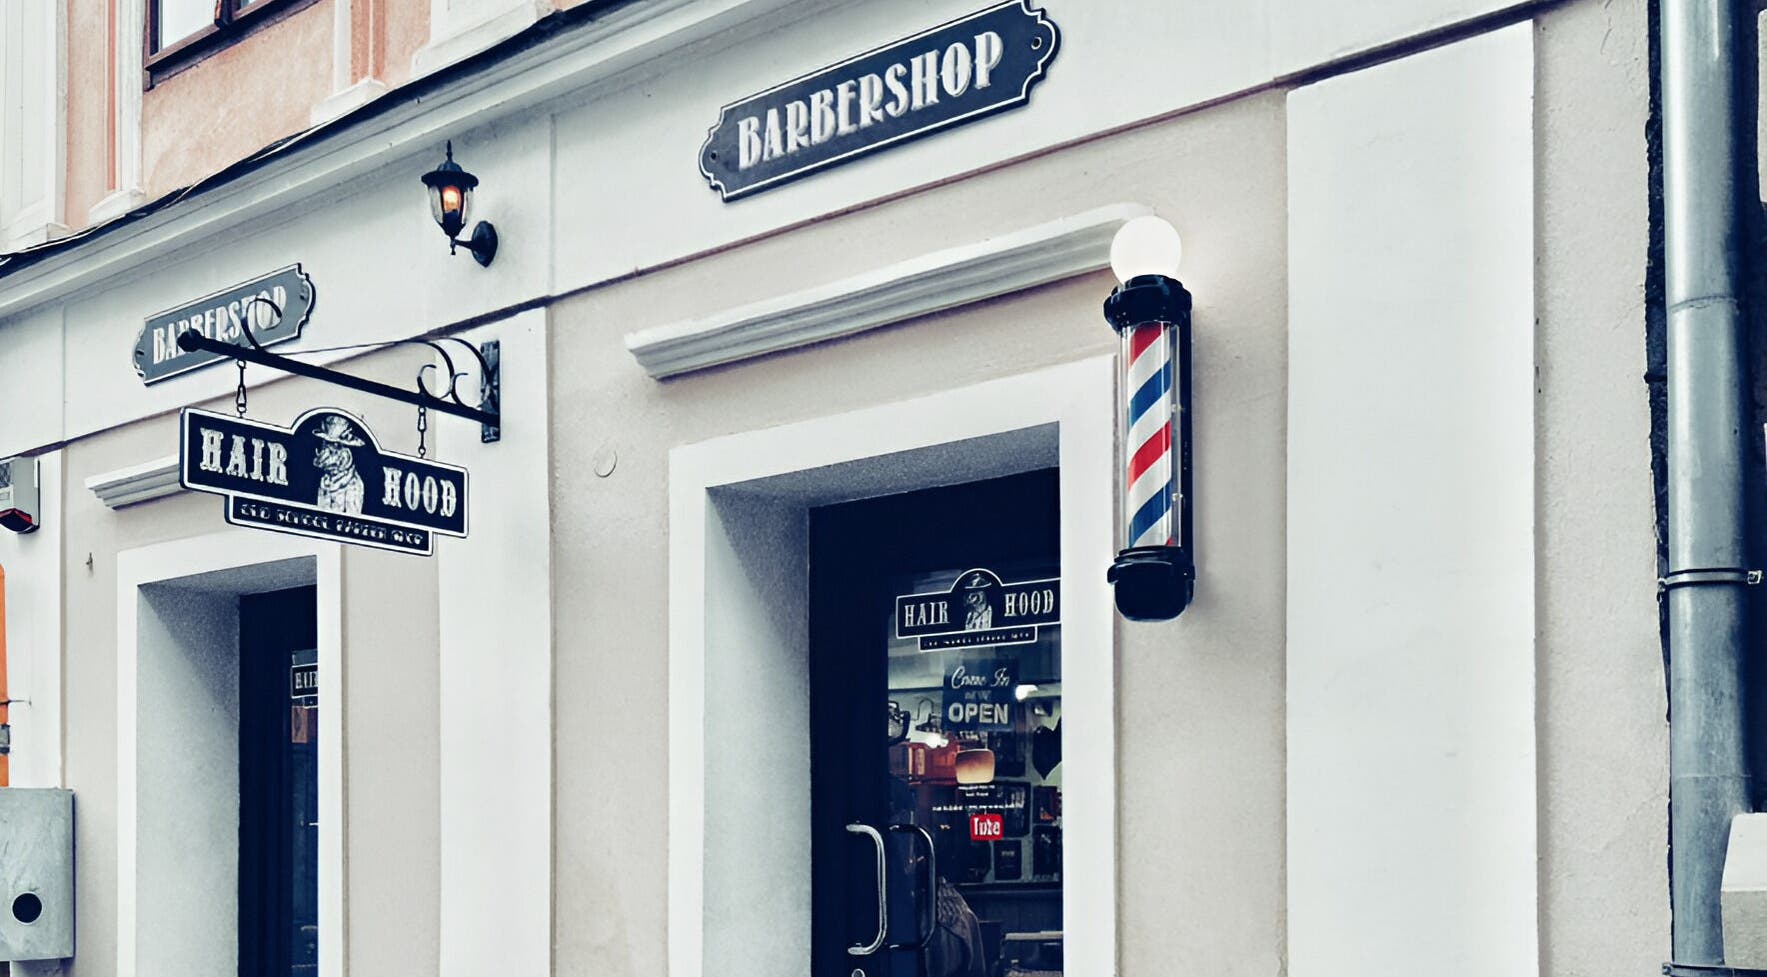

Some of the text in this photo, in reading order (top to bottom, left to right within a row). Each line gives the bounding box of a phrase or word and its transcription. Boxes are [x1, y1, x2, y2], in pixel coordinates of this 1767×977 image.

[738, 31, 1004, 171] BARBERSHOP
[199, 427, 457, 518] HAIR HOOD
[904, 589, 1055, 628] HAIR HOOD
[990, 667, 1010, 688] In
[948, 702, 1009, 725] OPEN
